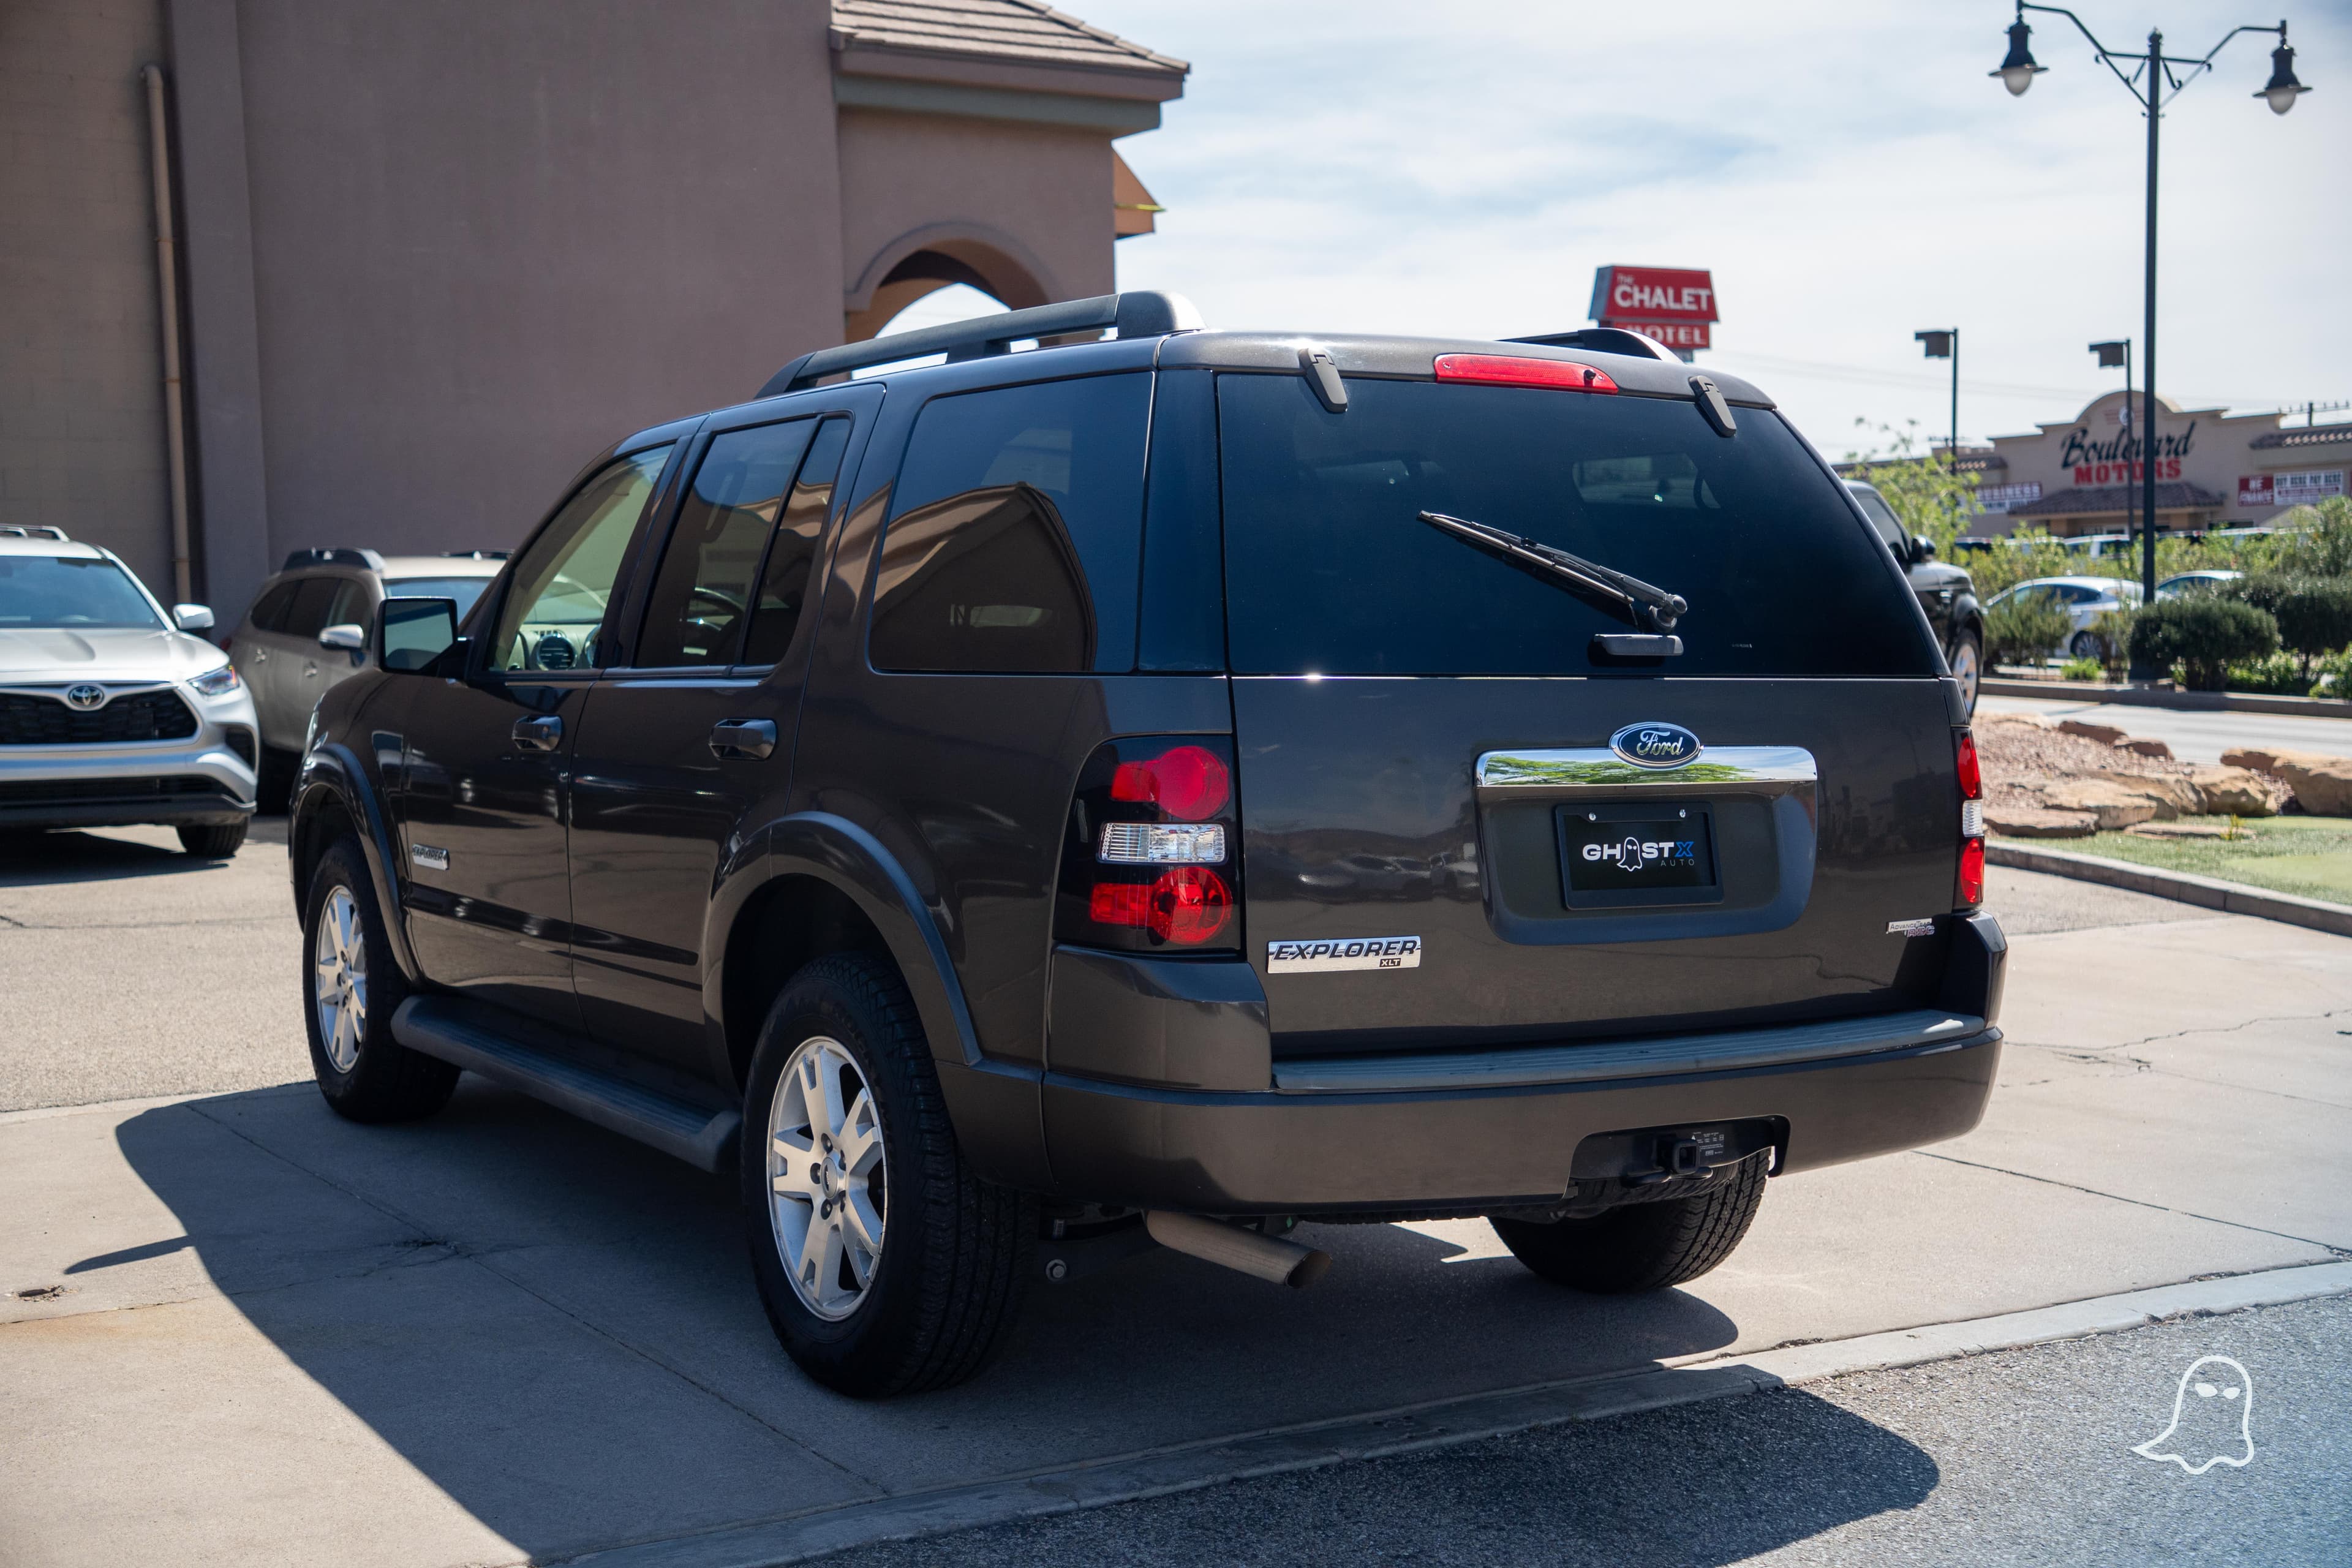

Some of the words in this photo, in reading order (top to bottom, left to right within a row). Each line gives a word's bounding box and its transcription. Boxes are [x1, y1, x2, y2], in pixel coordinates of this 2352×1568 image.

[1614, 284, 1712, 311] CHALET
[2310, 475, 2321, 484] PAY
[1637, 729, 1684, 756] Ford
[1660, 859, 1695, 867] AUTO
[1907, 925, 1936, 937] RSC
[1272, 939, 1418, 961] EXPLORER
[1380, 958, 1401, 967] XLT
